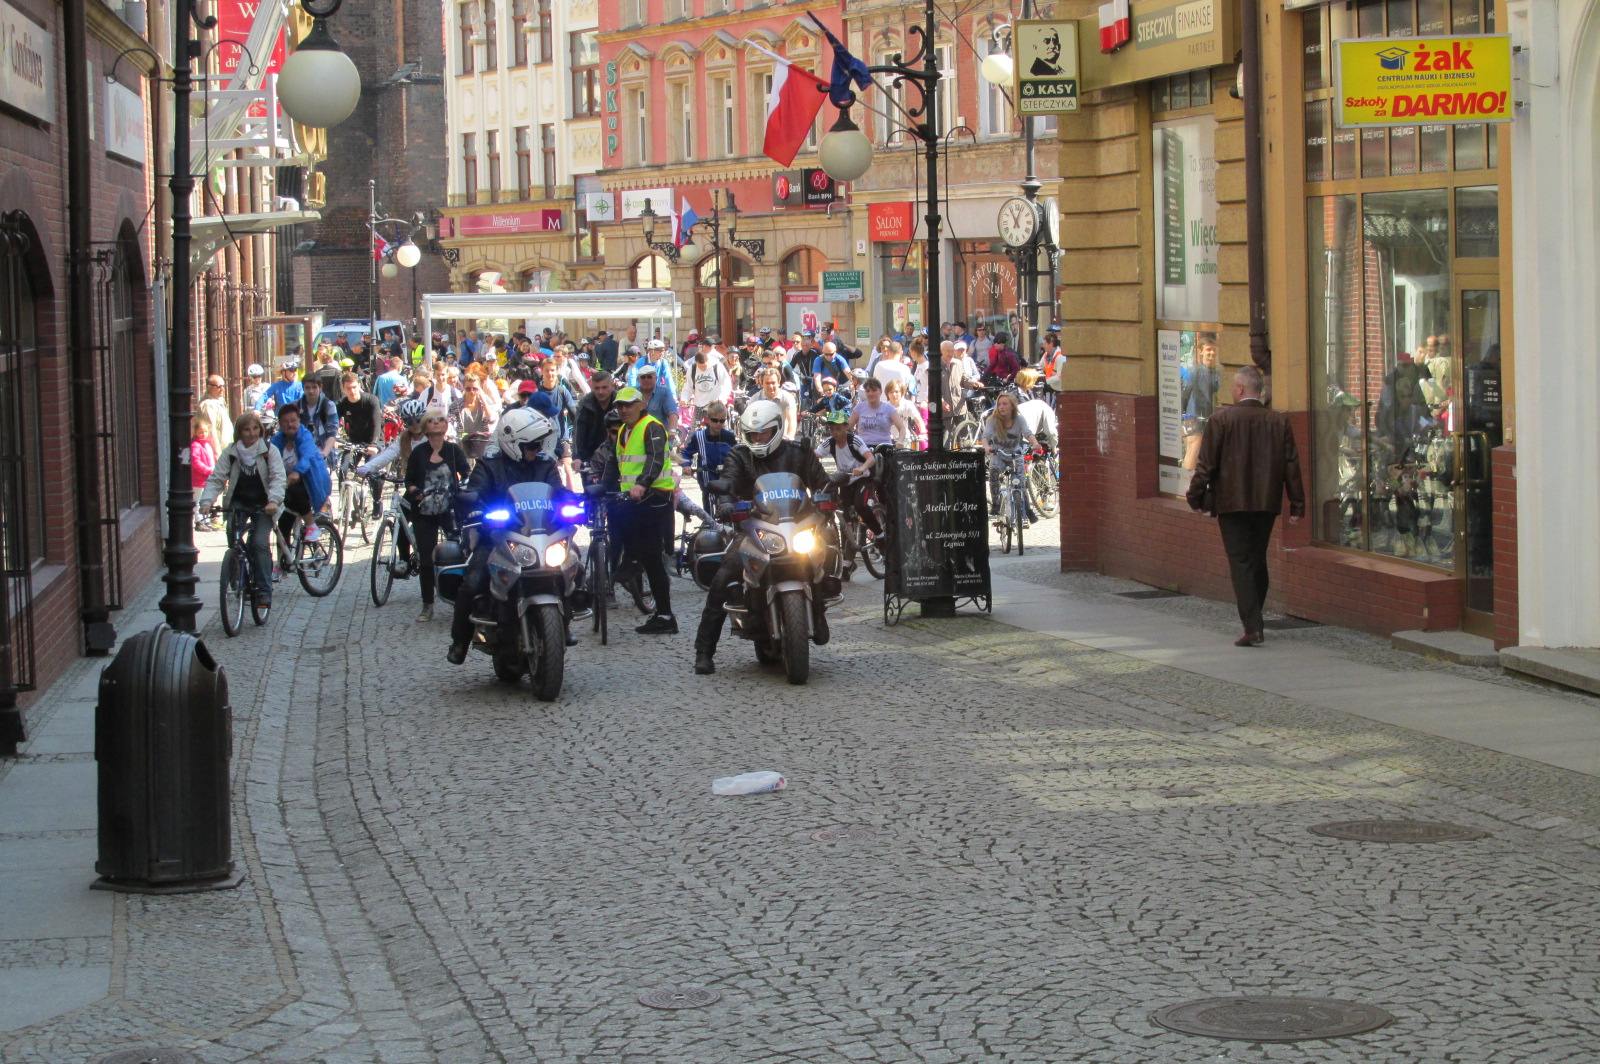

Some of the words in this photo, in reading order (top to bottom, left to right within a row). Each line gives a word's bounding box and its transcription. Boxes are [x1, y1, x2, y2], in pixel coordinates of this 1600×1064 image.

[1137, 15, 1174, 42] STEFCZYK
[1177, 5, 1212, 32] FINANSE
[1187, 40, 1215, 57] PARTNER
[1414, 41, 1474, 72] żak
[1444, 72, 1475, 80] BIZNESU
[1038, 83, 1073, 96] KASY
[1023, 98, 1074, 110] STEFCZYKA
[1345, 96, 1387, 109] Szkoły
[1391, 91, 1507, 118] DARMO!
[1374, 109, 1387, 117] za
[493, 215, 520, 227] Millennium
[548, 216, 561, 230] M
[876, 215, 903, 230] SALON
[983, 278, 1004, 299] Styl
[901, 463, 921, 472] Salon
[923, 462, 947, 471] Sukien
[920, 471, 967, 481] wieczorowych
[763, 488, 801, 502] POLICJA
[515, 499, 554, 512] POLICJA
[923, 502, 951, 513] Atelier
